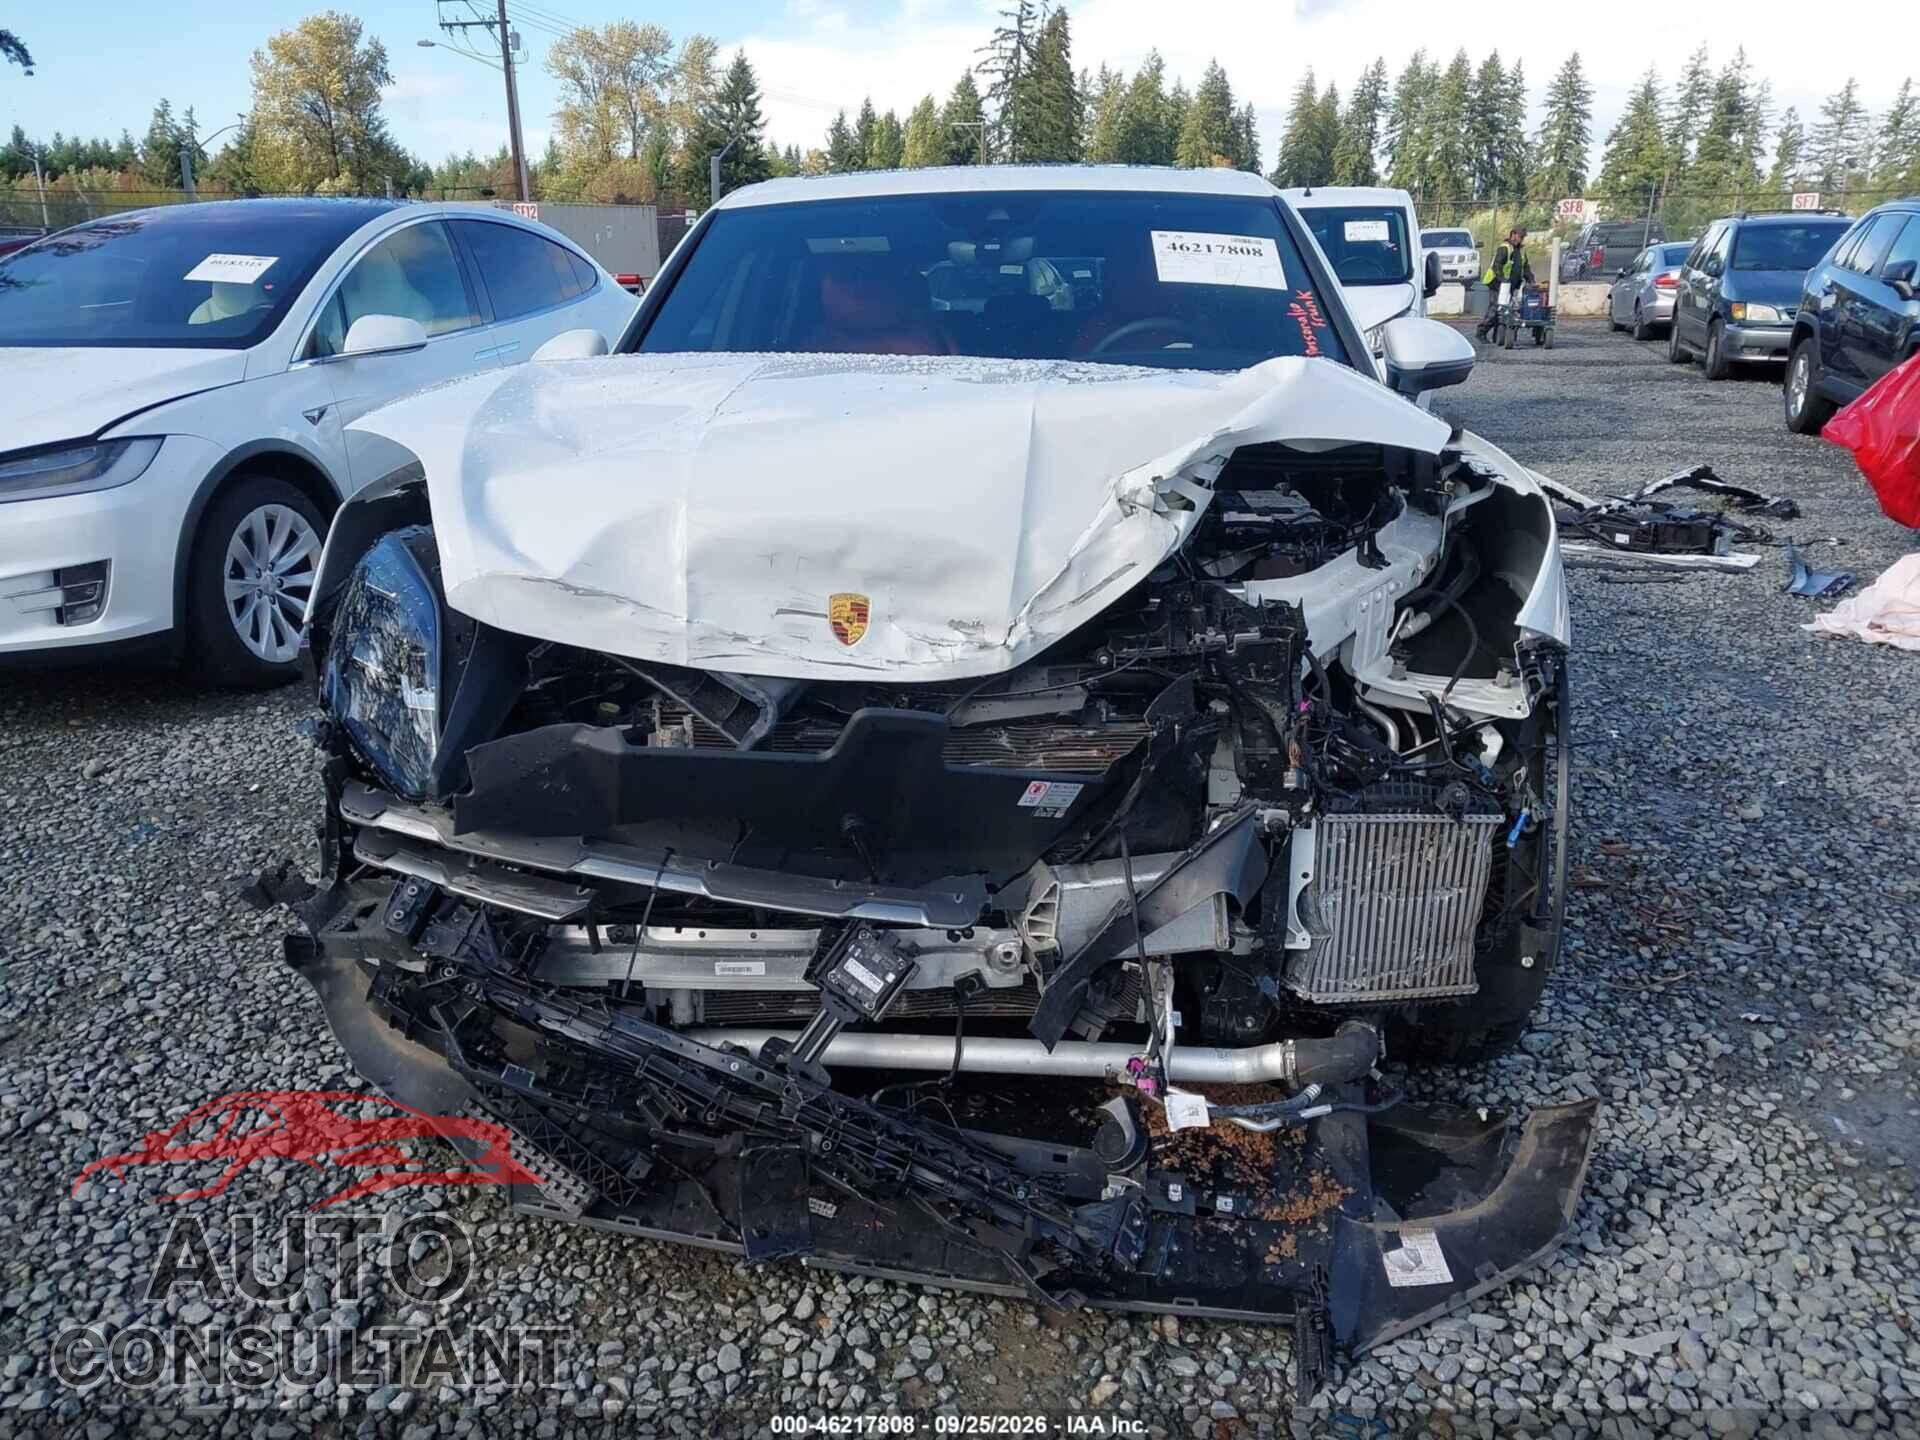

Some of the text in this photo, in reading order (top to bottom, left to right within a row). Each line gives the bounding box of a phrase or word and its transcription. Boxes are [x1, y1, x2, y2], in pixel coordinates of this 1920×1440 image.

[1561, 200, 1584, 214] SF8
[1795, 197, 1817, 209] SF7
[1166, 241, 1265, 257] 46217808
